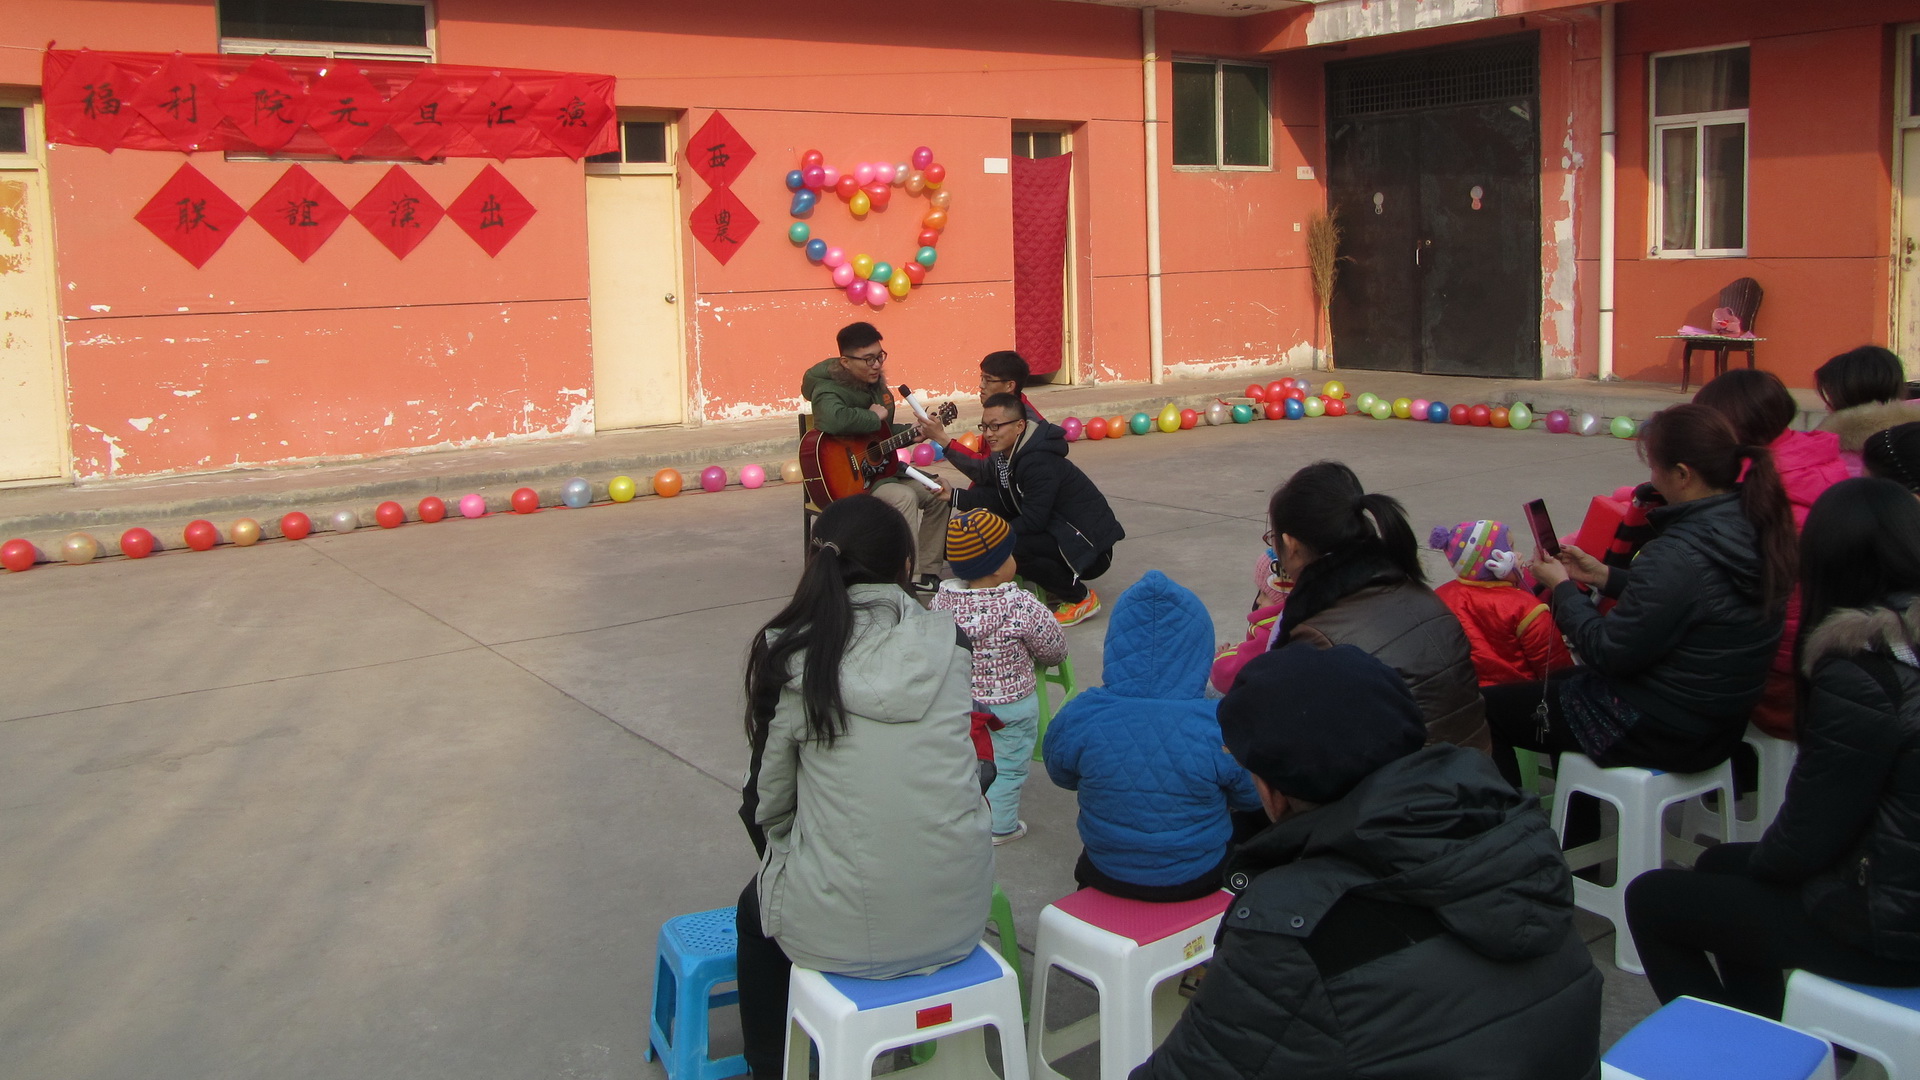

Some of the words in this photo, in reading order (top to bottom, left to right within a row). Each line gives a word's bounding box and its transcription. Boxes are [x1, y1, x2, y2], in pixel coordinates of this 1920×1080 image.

[81, 83, 588, 129] 福利院元旦汇演
